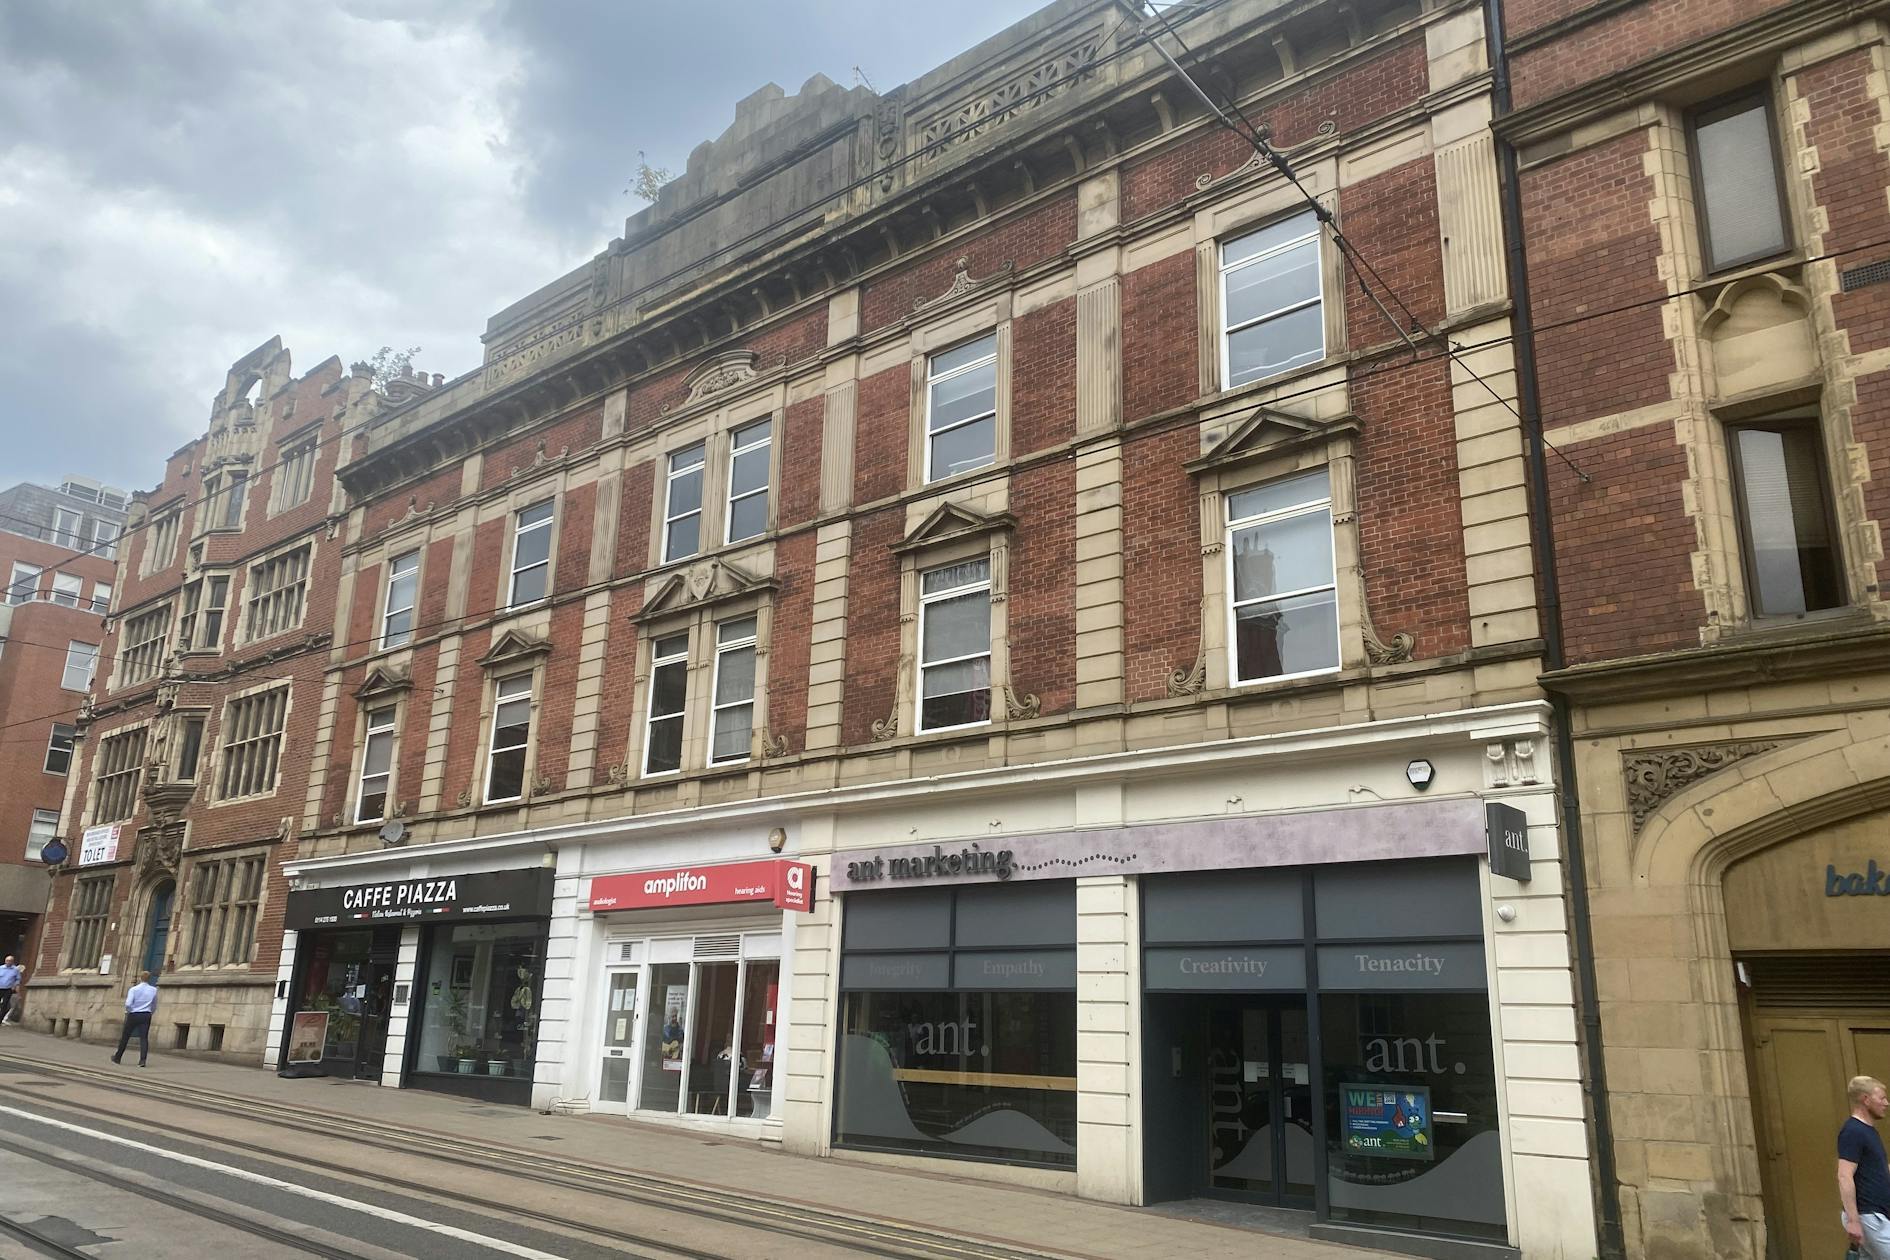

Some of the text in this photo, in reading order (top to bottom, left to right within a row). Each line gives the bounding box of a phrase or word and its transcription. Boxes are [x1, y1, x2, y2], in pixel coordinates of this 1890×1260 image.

[1504, 830, 1528, 853] ant.
[83, 847, 105, 862] TO LET
[847, 856, 884, 880] ant
[1825, 859, 1890, 897] bak
[344, 880, 457, 909] CAFFE PIAZZA
[644, 871, 707, 898] amplifon
[734, 885, 766, 896] hearing aids
[869, 961, 923, 980] Integrity
[983, 959, 1046, 978] Empathy
[1180, 956, 1268, 977] Creativity
[1355, 954, 1445, 976] Tenacity
[916, 1015, 990, 1057] ant.
[1365, 1031, 1467, 1075] ant.
[1348, 1090, 1377, 1107] WE
